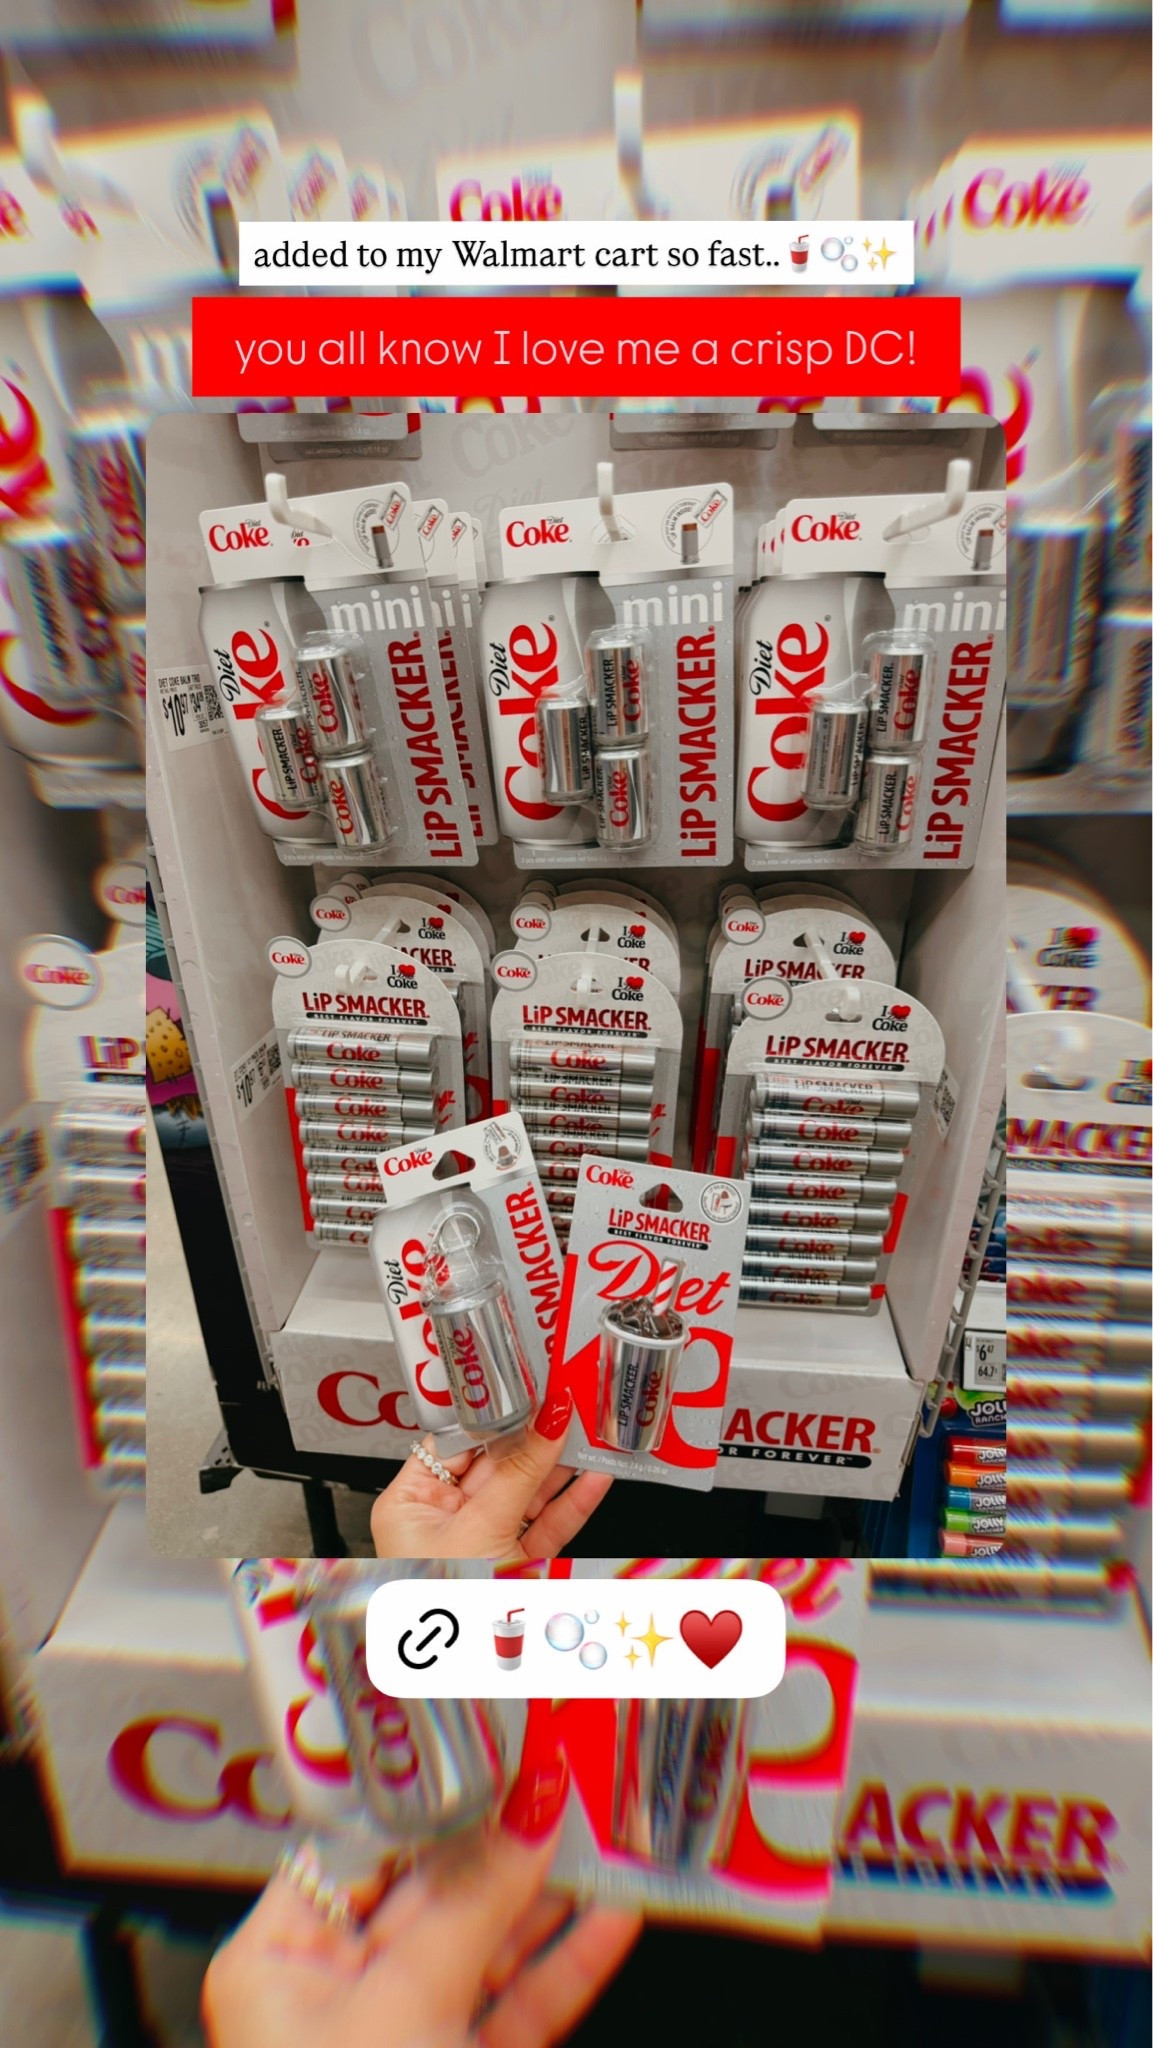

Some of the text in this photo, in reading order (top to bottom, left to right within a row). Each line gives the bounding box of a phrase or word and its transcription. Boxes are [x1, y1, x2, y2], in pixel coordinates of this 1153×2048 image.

[208, 523, 272, 552] Coke
[506, 519, 570, 548] Coke
[791, 515, 860, 543] Coke
[330, 585, 425, 632] mini
[622, 581, 723, 627] mini
[213, 648, 241, 702] Diet
[489, 643, 510, 697] Diet
[750, 640, 774, 696] Diet
[623, 659, 641, 722] Coke
[893, 669, 920, 731] Coke
[313, 672, 340, 733] Coke
[331, 780, 354, 835] Coke
[609, 770, 629, 827] Coke
[316, 908, 346, 920] Coke
[516, 918, 547, 930] Coke
[418, 928, 446, 940] Coke
[728, 920, 760, 933] Coke
[617, 937, 646, 949] Coke
[833, 943, 864, 955] Coke
[272, 952, 305, 965] Coke
[387, 977, 418, 989] Coke
[497, 966, 531, 979] Coke
[612, 989, 644, 1001] Coke
[747, 993, 785, 1006] Coke
[872, 1018, 908, 1032] Coke
[327, 1041, 380, 1063] Coke
[330, 1068, 384, 1089] Coke
[335, 1096, 387, 1118] Coke
[337, 1122, 388, 1143] Coke
[798, 1120, 860, 1141] Coke
[384, 1151, 434, 1176] Coke
[586, 1164, 634, 1188] Coke
[384, 1259, 408, 1305] Diet
[453, 1327, 490, 1409] Coke
[752, 1450, 846, 1465] FOREVER
